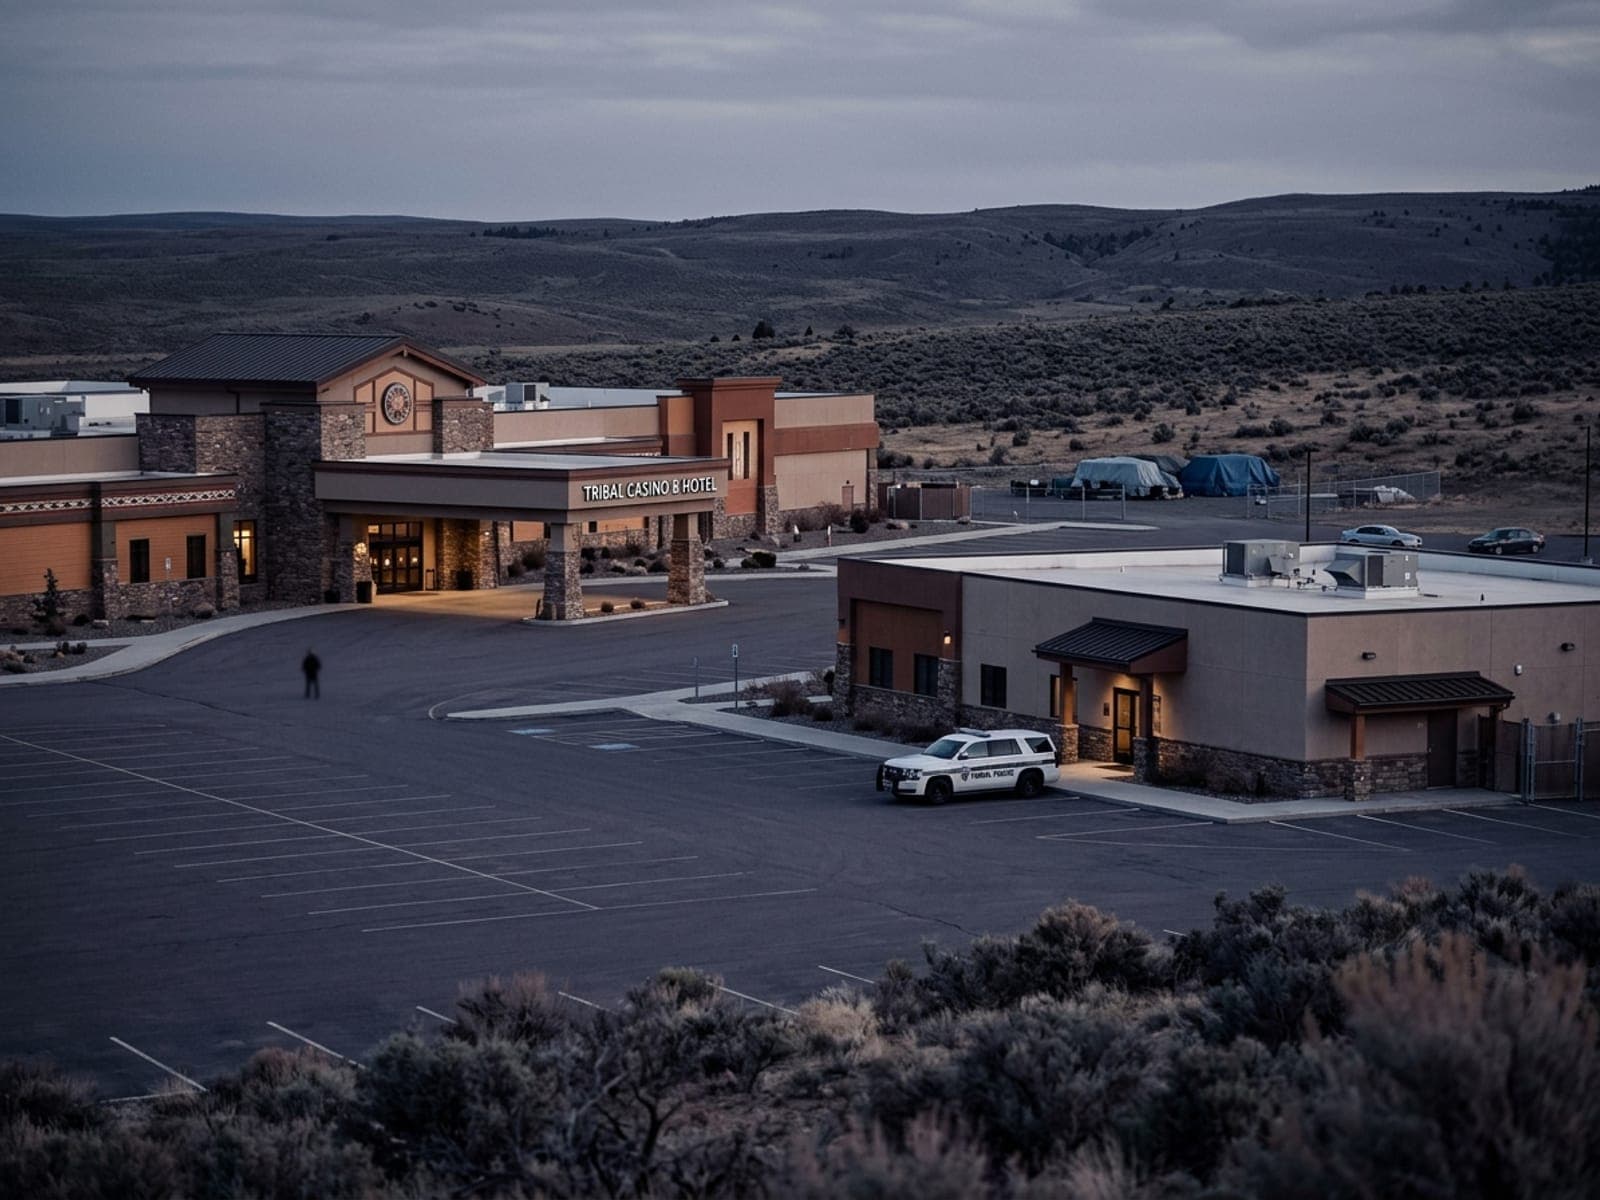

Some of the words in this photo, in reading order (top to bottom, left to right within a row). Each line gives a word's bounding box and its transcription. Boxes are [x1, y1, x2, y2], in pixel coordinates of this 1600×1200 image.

[583, 484, 624, 501] TRIBAL
[627, 480, 669, 497] CASINO
[682, 476, 718, 493] HOTEL
